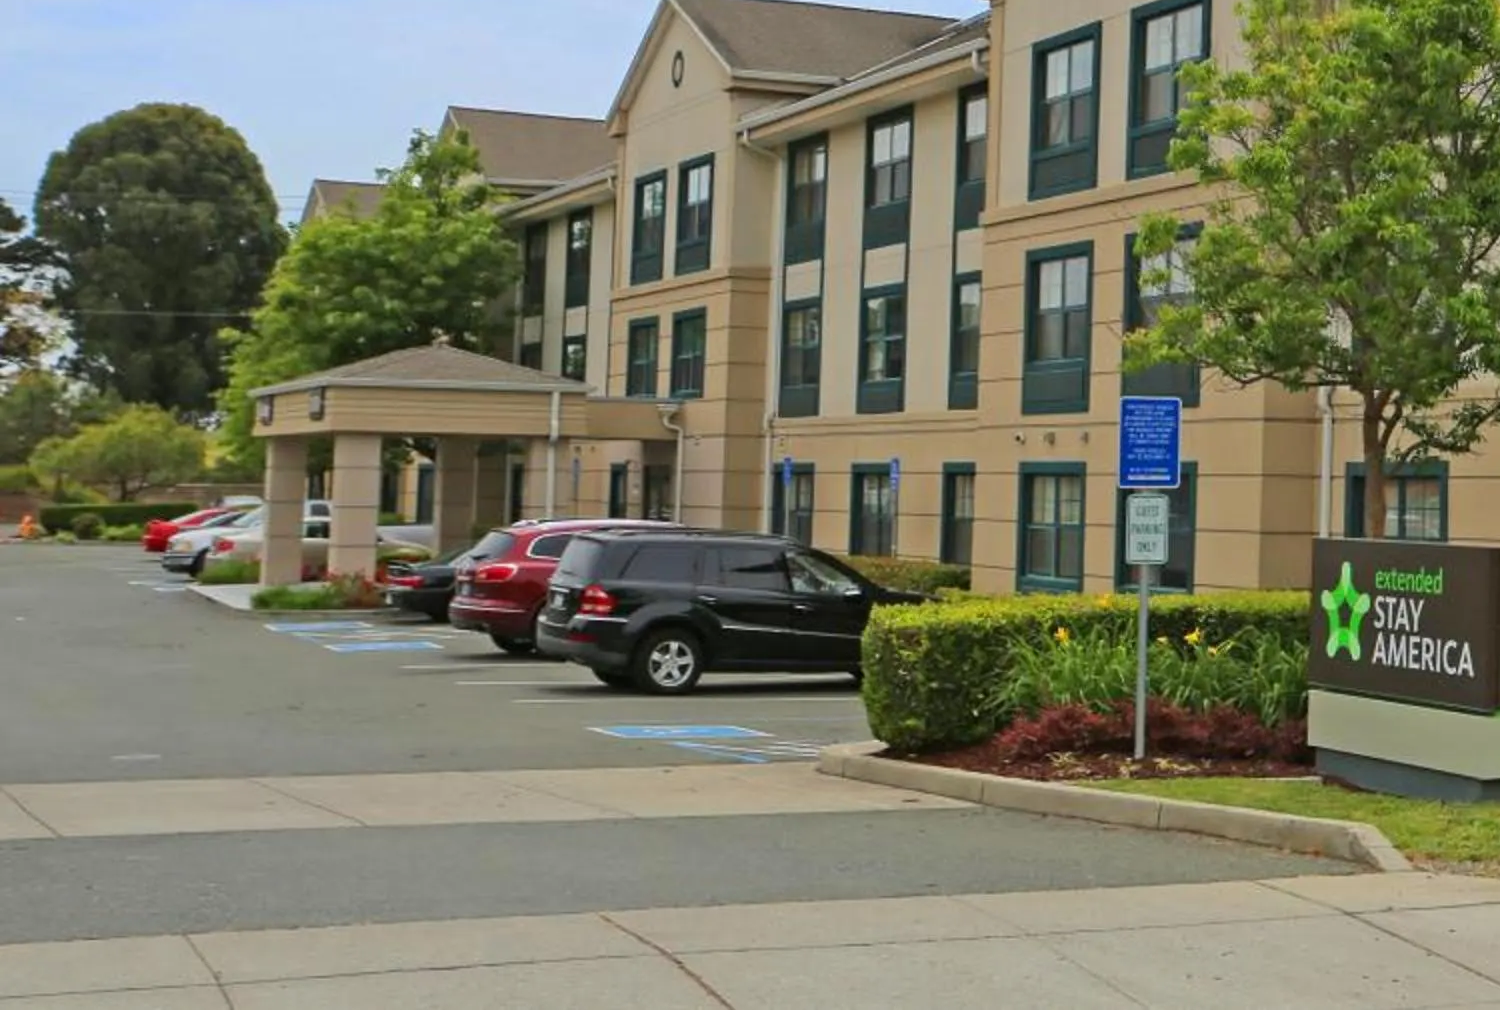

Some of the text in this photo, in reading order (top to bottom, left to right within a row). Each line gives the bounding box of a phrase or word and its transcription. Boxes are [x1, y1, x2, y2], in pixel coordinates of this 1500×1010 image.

[1375, 566, 1443, 594] extended
[1373, 595, 1424, 632] STAY
[1371, 631, 1475, 677] AMERICA
